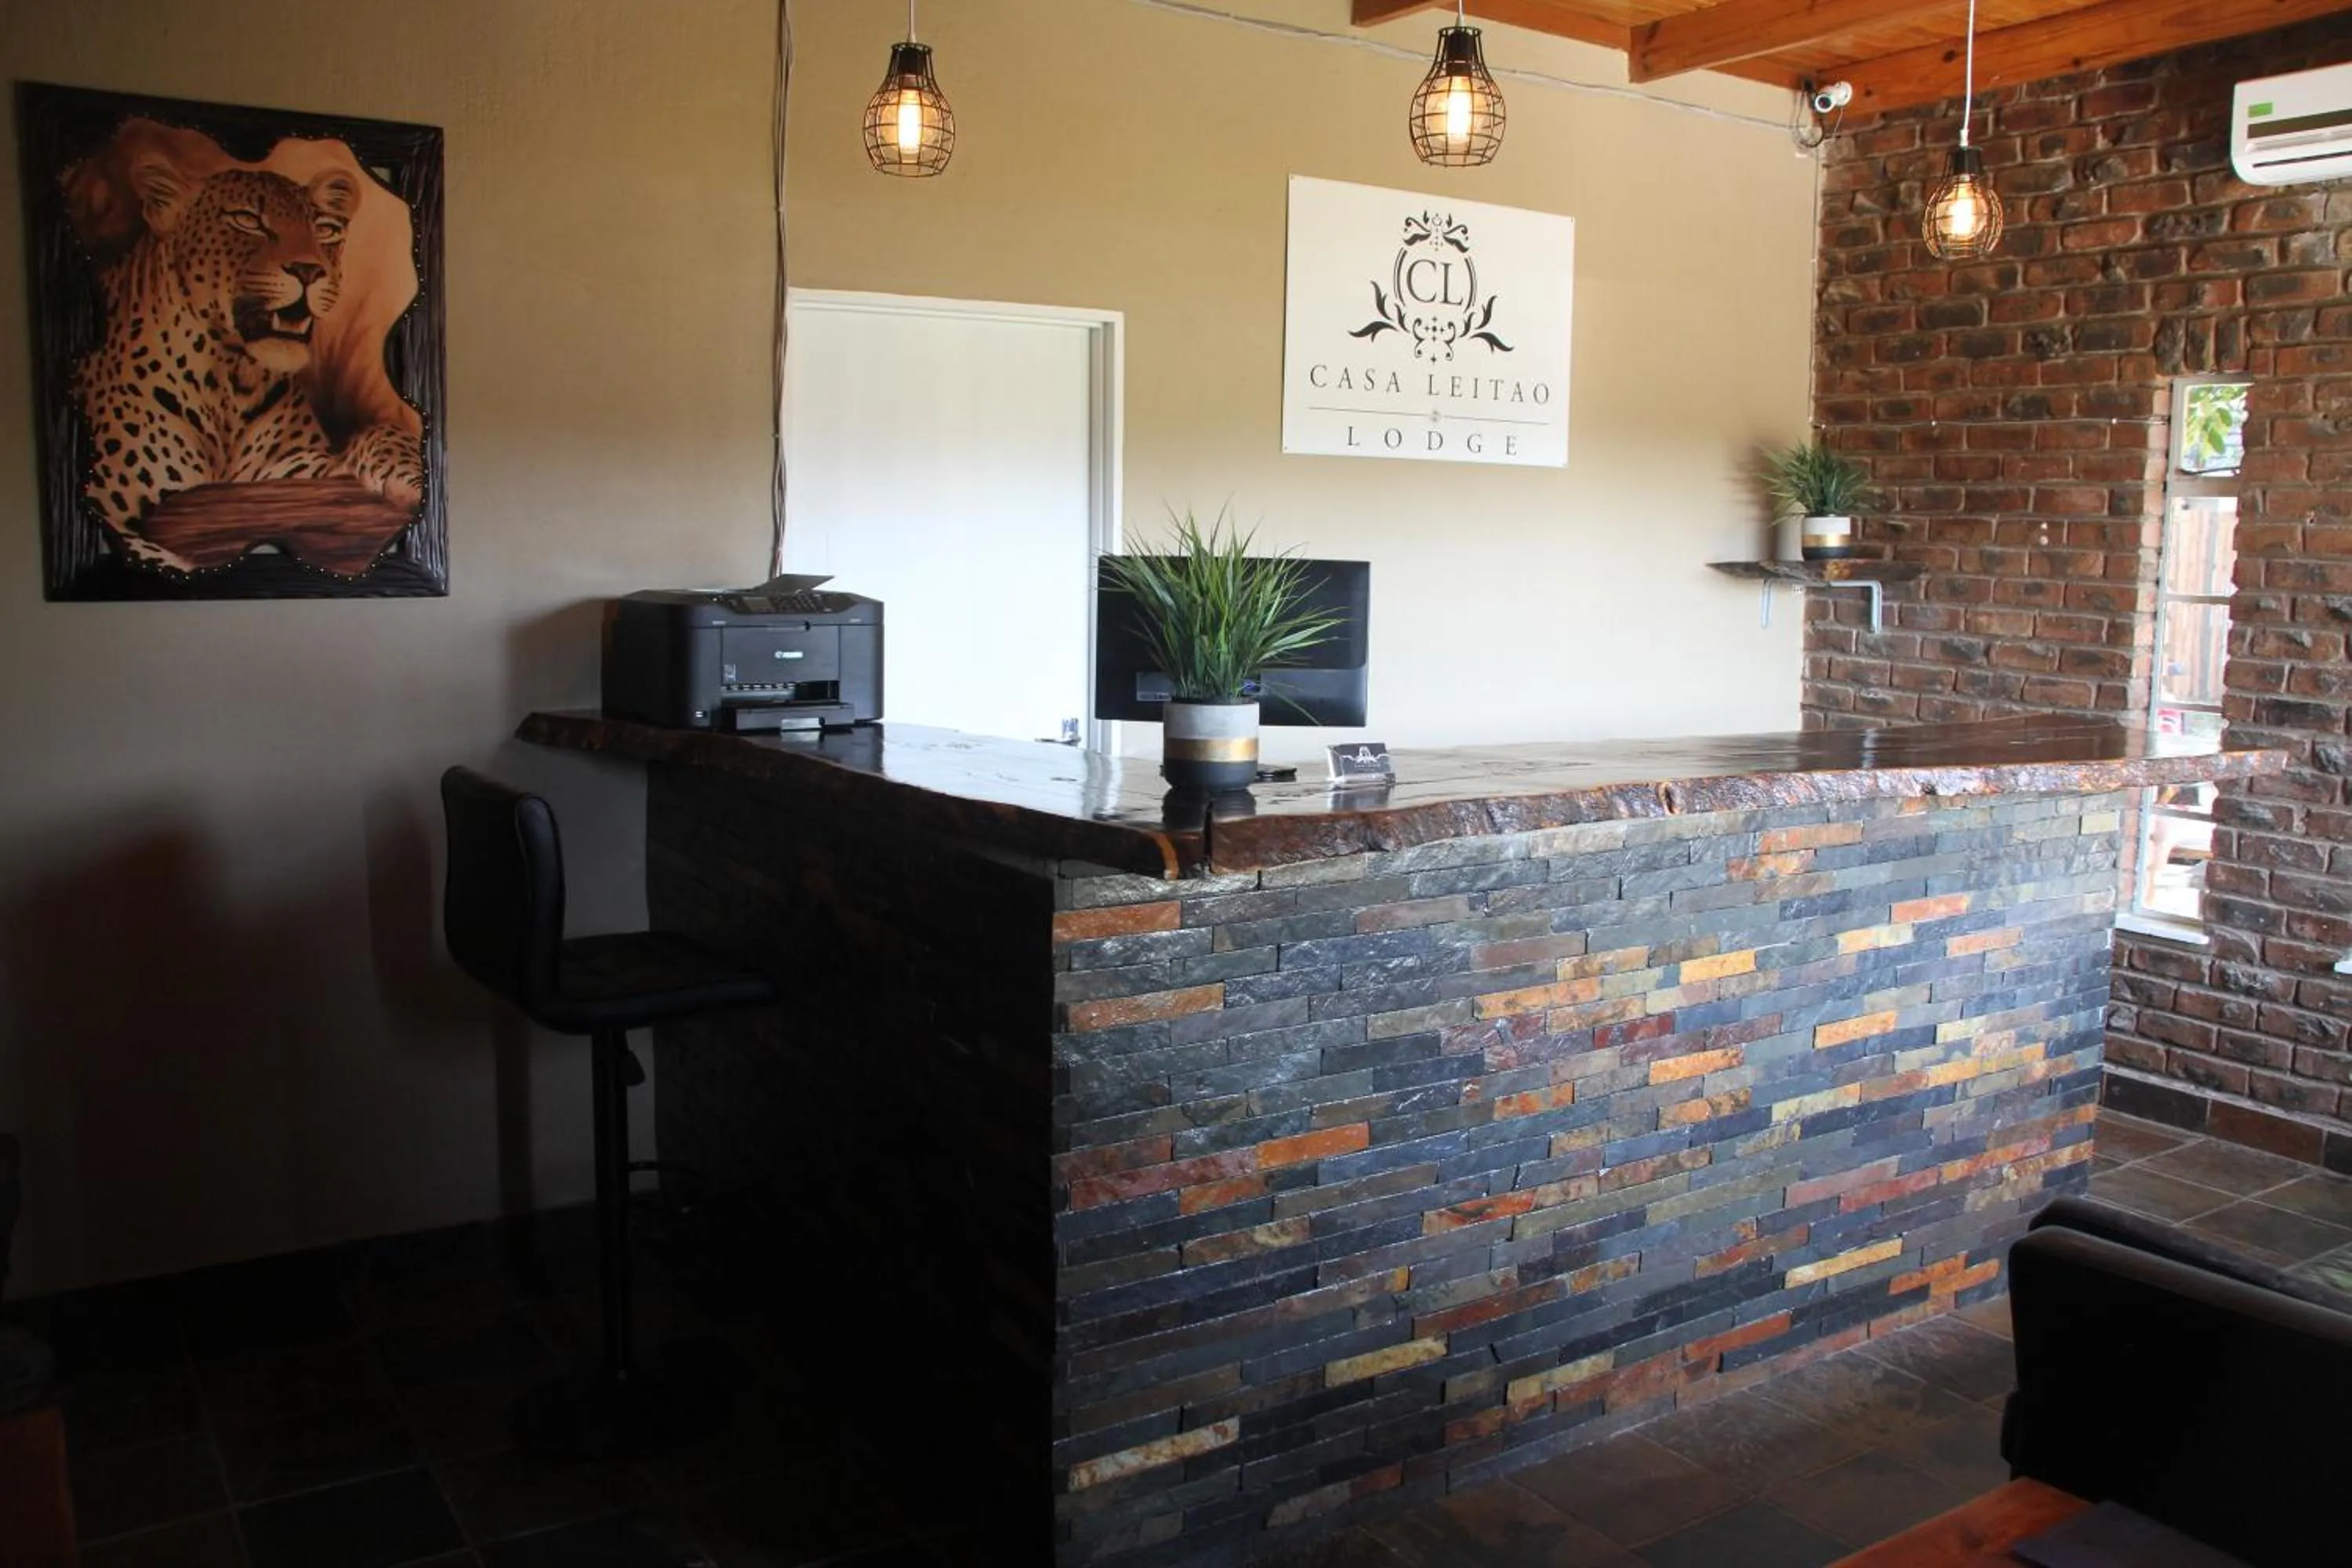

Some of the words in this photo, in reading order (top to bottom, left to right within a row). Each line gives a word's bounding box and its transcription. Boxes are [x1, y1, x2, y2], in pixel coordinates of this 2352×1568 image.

[1406, 259, 1465, 307] CL
[1310, 364, 1402, 394] CASA
[1428, 373, 1550, 405] LEITAO
[1347, 426, 1517, 456] LODGE
